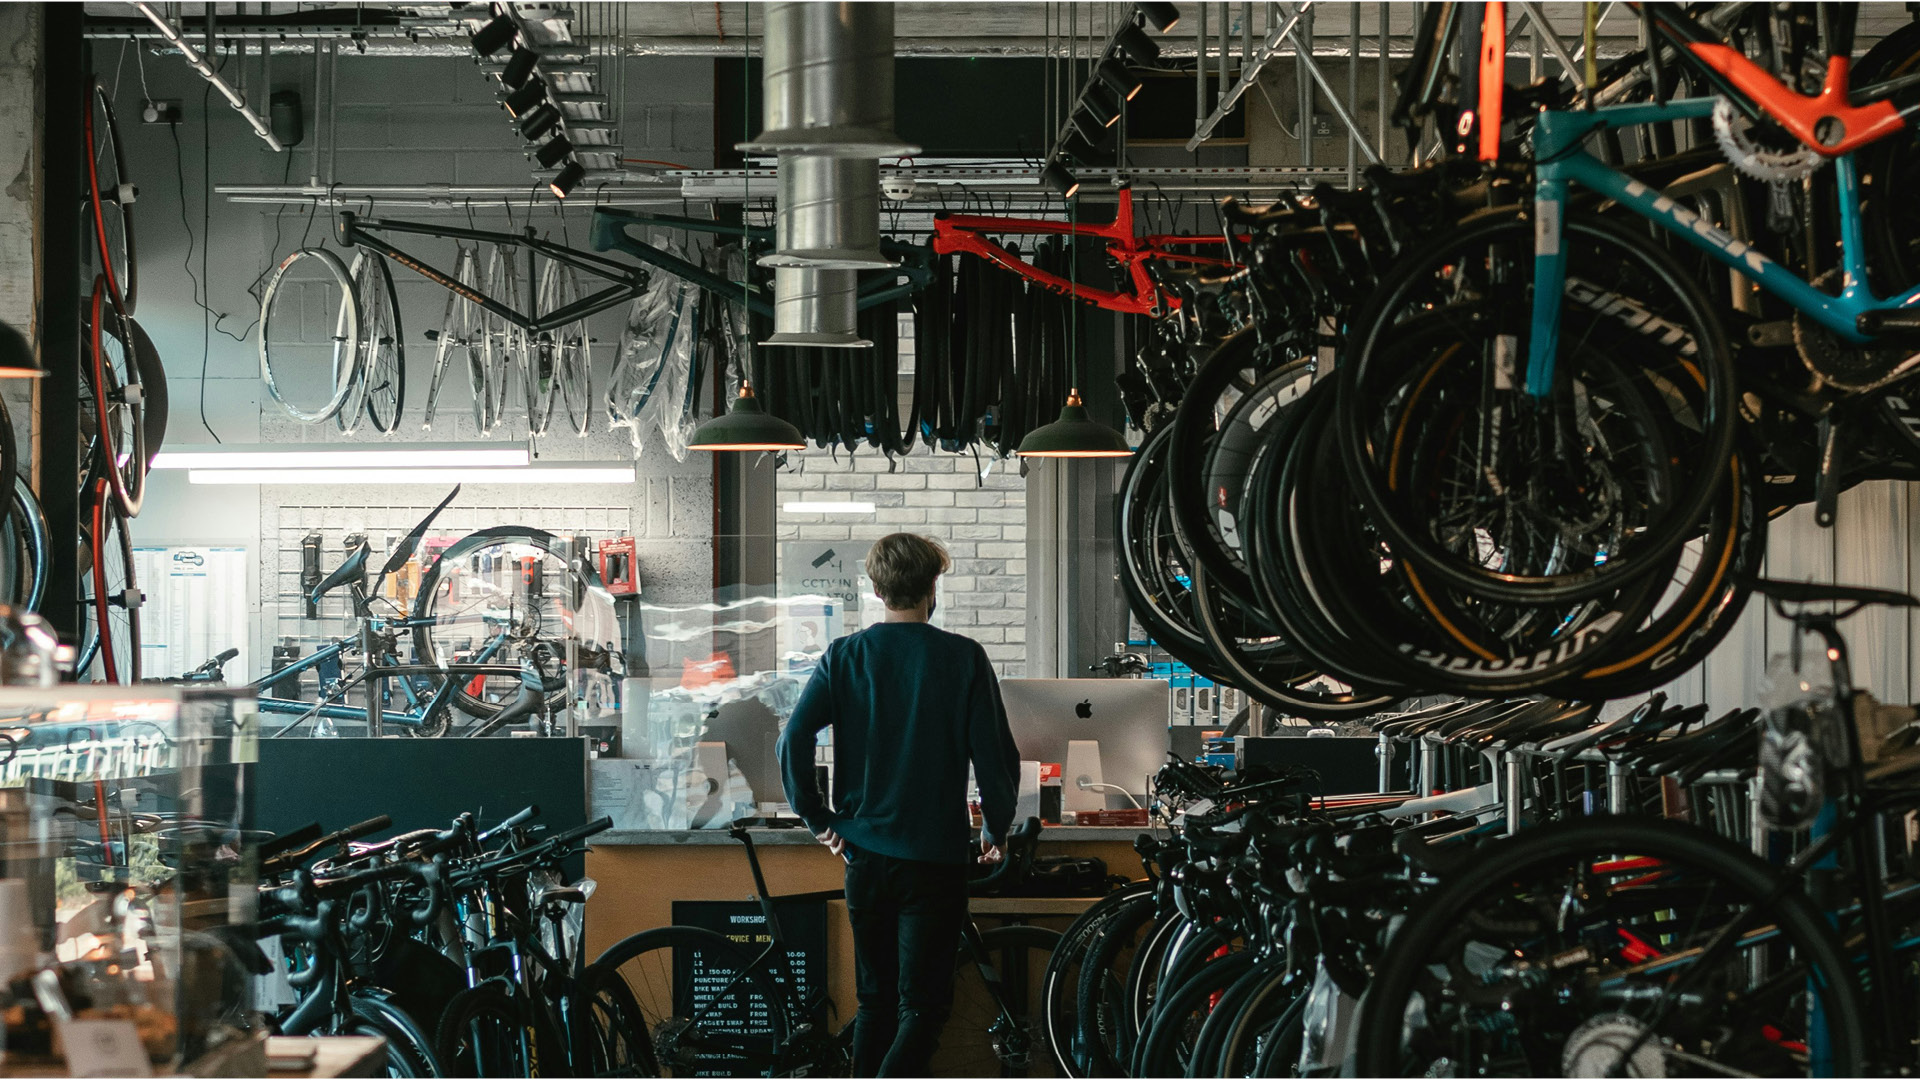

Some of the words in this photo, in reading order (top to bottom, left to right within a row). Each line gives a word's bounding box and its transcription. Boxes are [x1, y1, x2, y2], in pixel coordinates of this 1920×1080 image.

[1624, 181, 1773, 273] TREK
[801, 579, 833, 588] CCTV
[839, 579, 851, 588] IN
[726, 935, 750, 943] RVICE
[755, 935, 771, 943] MEN
